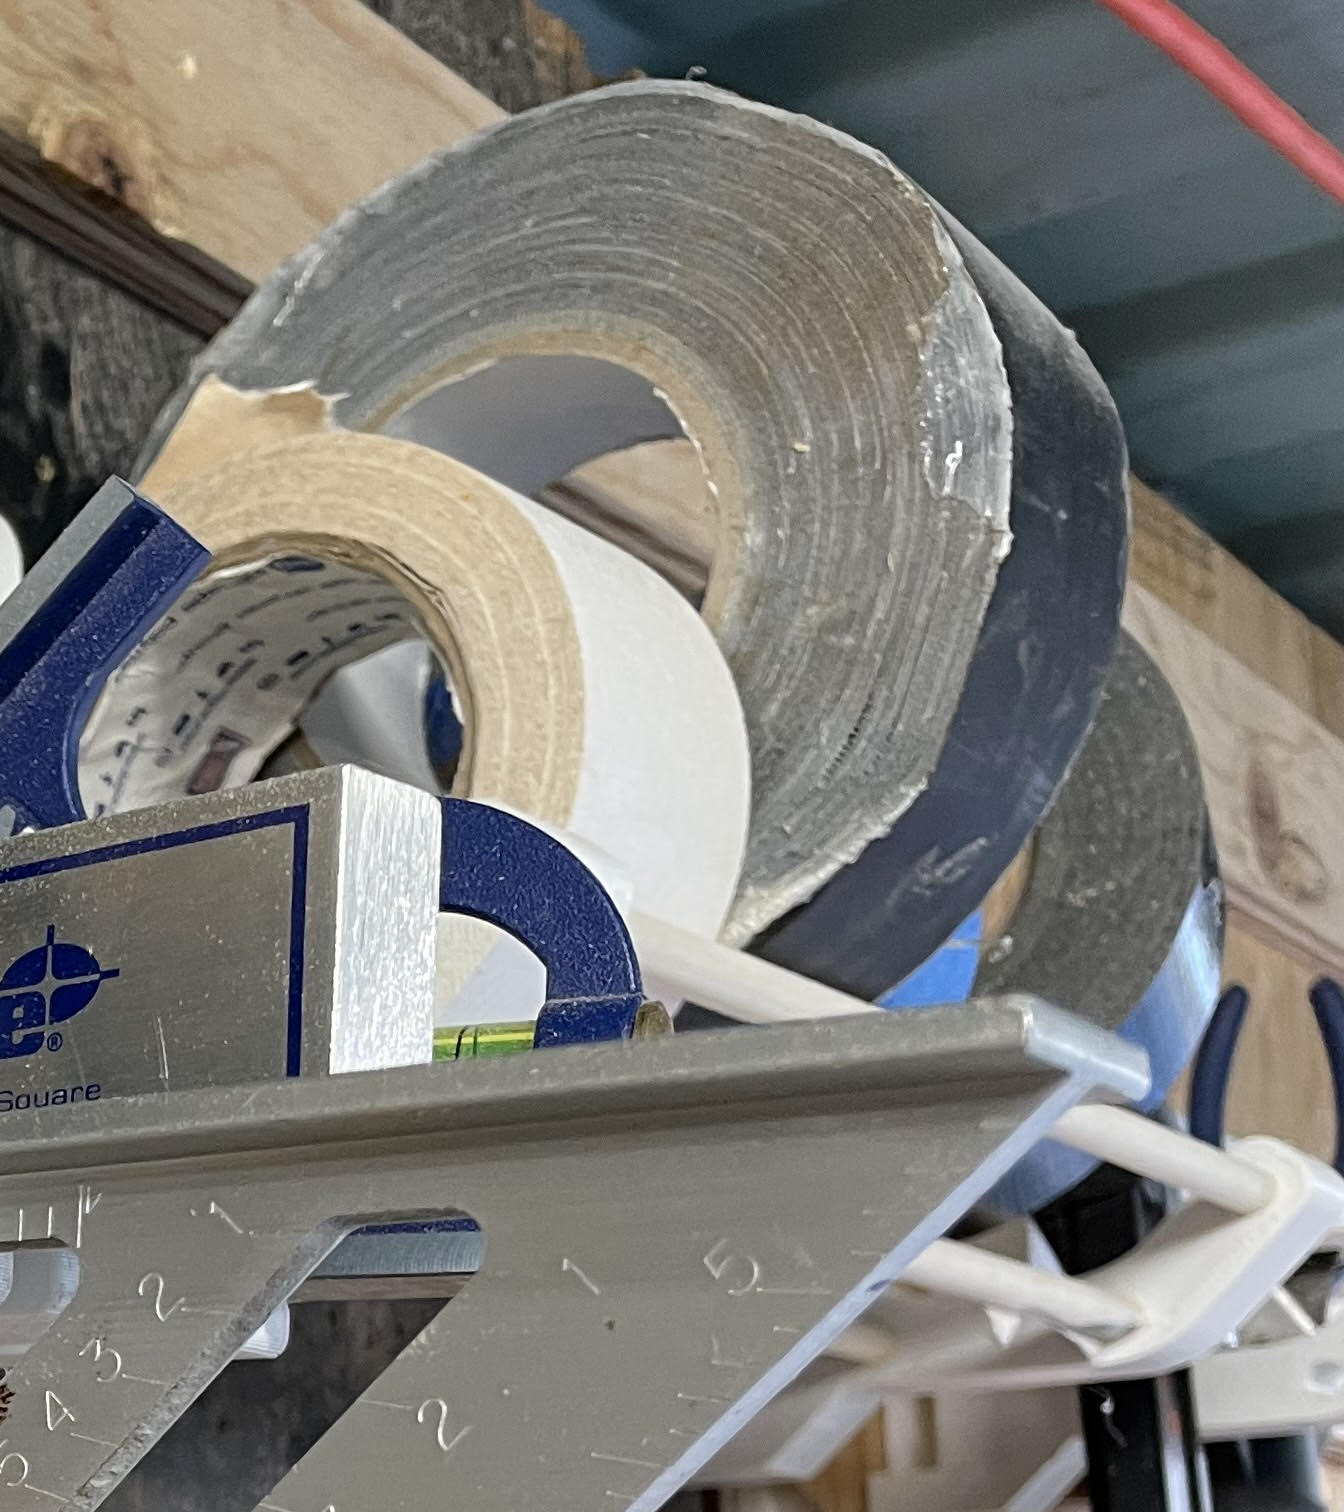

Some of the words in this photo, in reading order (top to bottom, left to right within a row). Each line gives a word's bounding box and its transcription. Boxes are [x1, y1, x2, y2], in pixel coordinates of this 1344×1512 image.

[704, 1240, 762, 1297] 5
[138, 1271, 186, 1323] 2
[79, 1338, 123, 1384] 3
[45, 1389, 76, 1432] 4
[417, 1397, 476, 1452] 2
